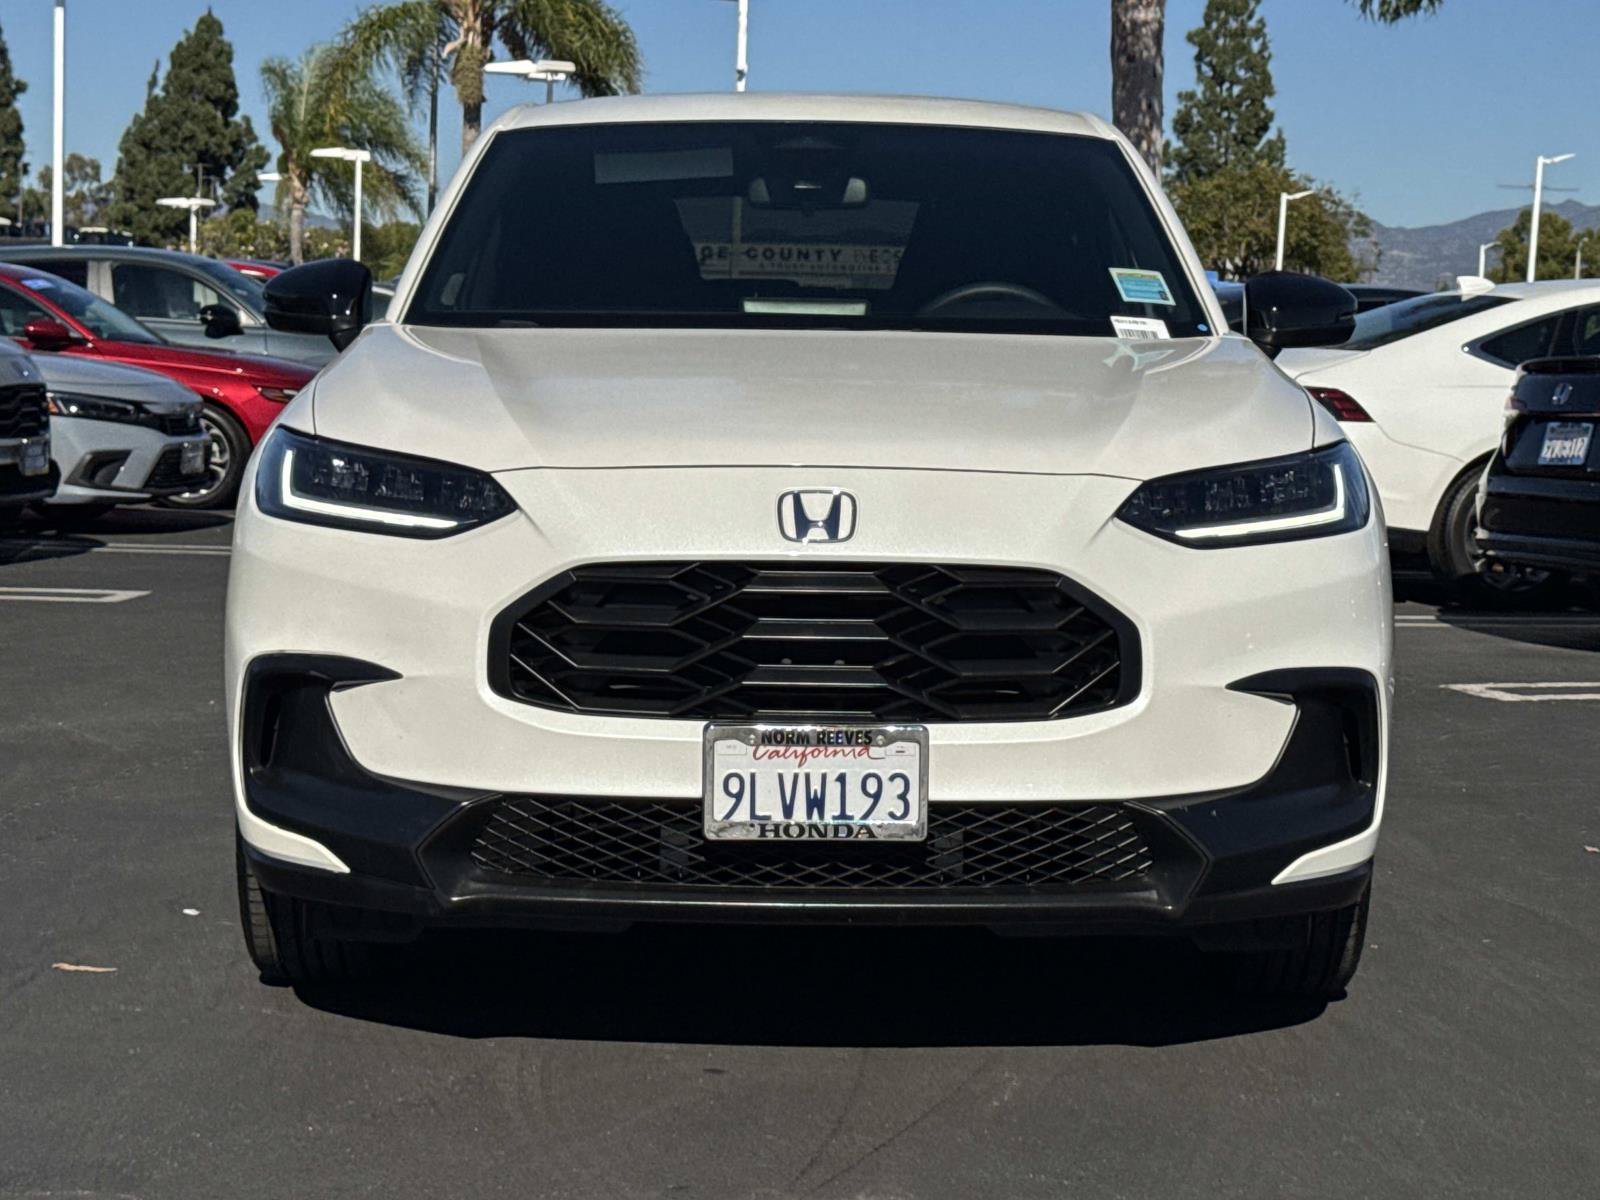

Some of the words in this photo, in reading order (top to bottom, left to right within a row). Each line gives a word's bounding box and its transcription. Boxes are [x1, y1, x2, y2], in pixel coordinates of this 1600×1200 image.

[745, 247, 843, 261] COUNTY
[761, 730, 810, 745] NORM
[817, 730, 873, 745] REEVES
[752, 745, 885, 768] California
[722, 772, 911, 821] 9LVW193
[758, 824, 878, 839] HONDA
